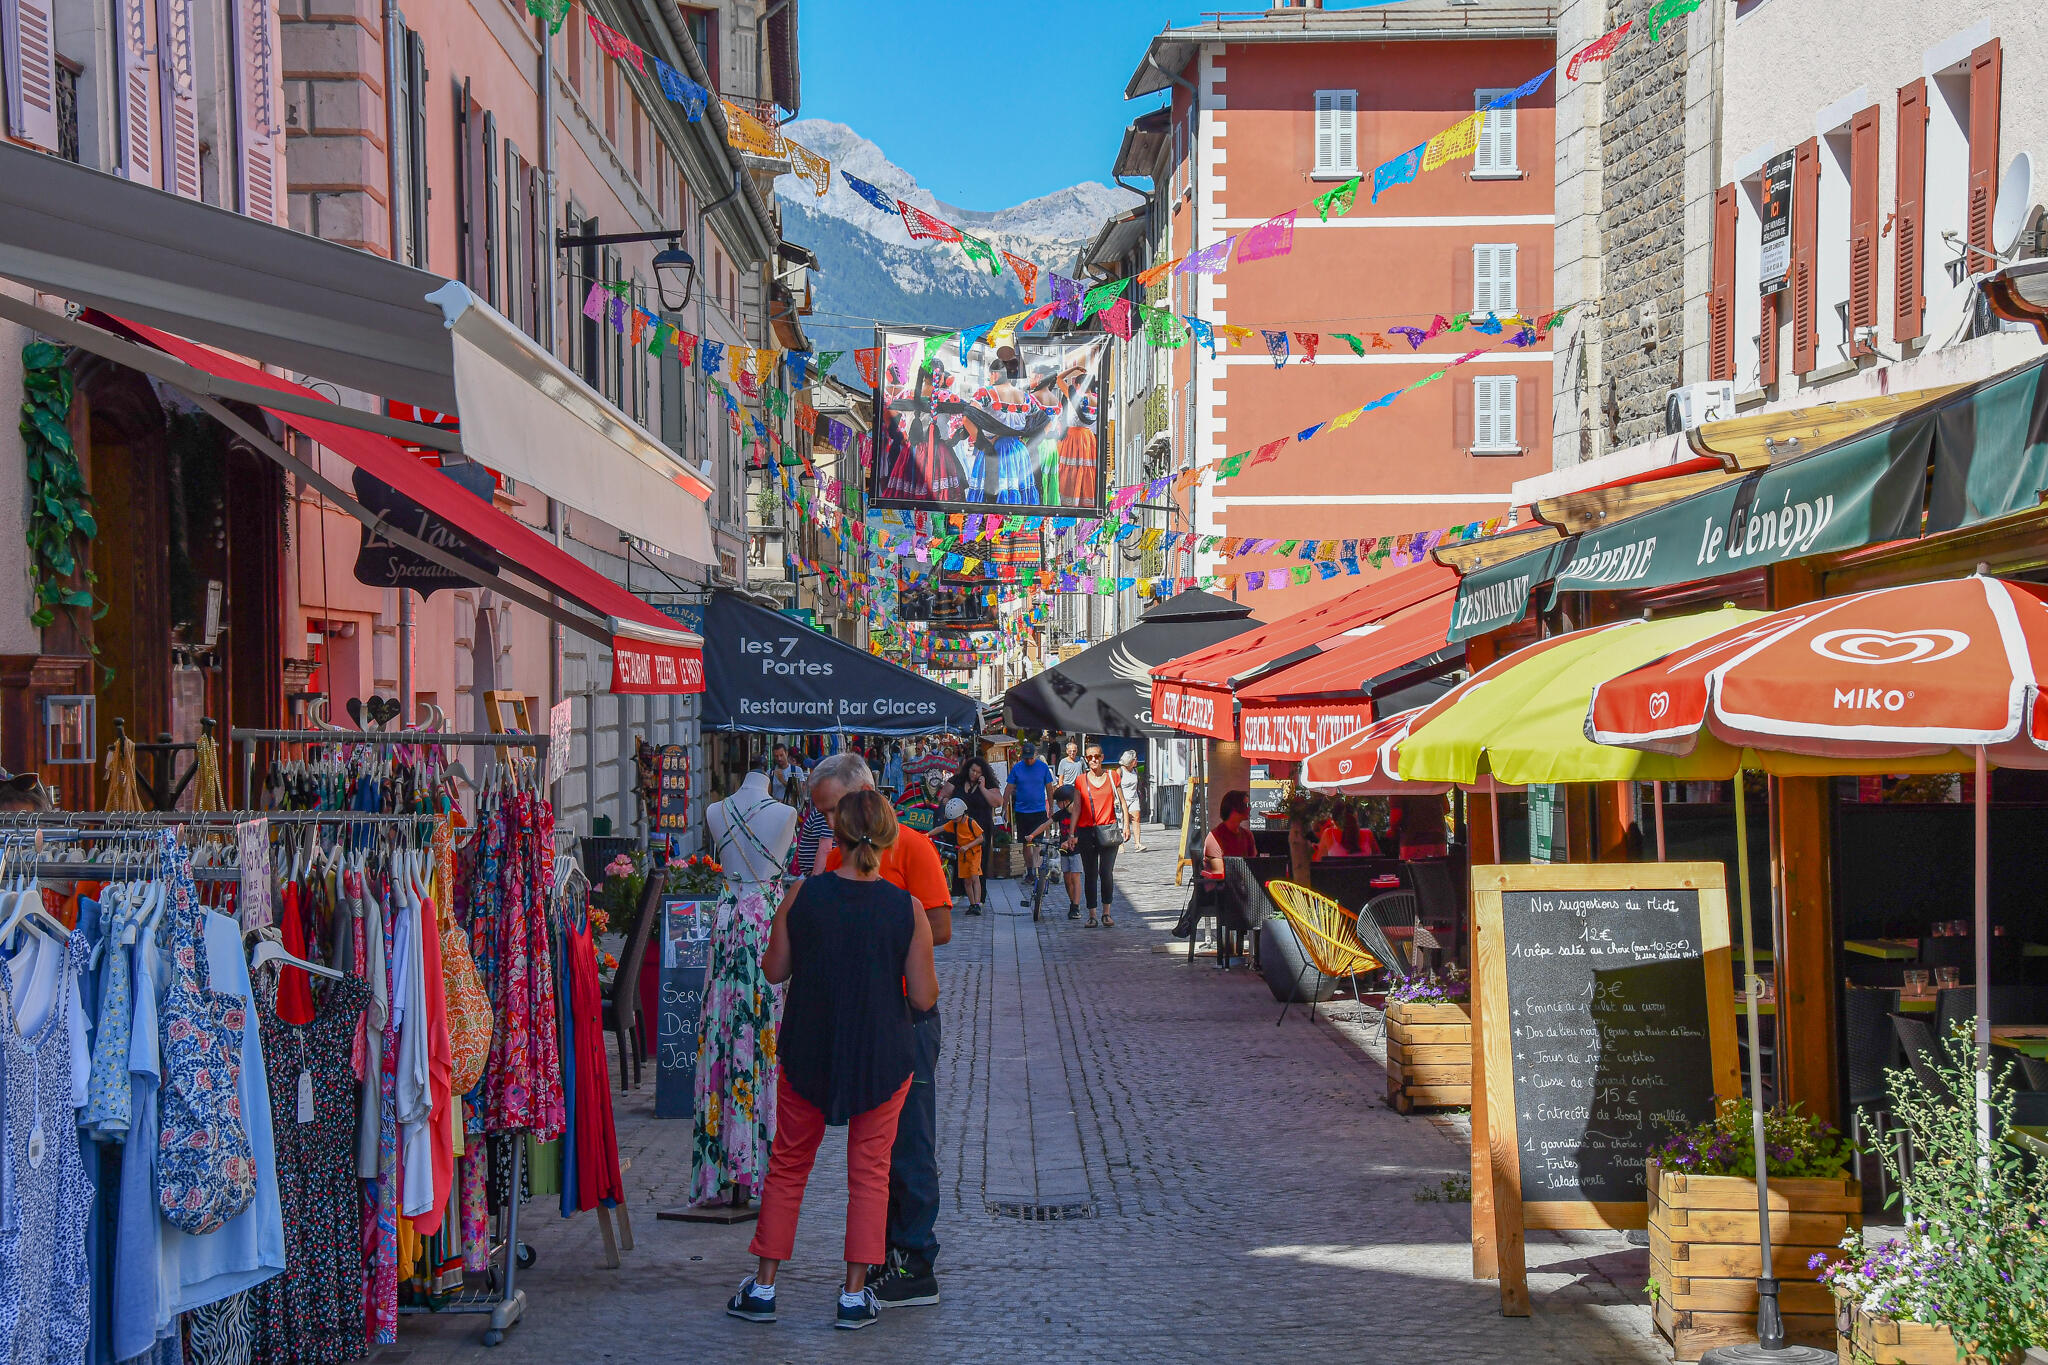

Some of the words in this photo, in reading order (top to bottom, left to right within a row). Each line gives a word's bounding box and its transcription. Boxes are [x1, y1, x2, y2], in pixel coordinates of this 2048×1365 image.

[1697, 516, 1723, 566] le
[1728, 488, 1834, 559] Génépy
[1454, 574, 1529, 630] RESTAURANT
[740, 637, 774, 654] les
[778, 637, 799, 658] 7
[616, 649, 652, 685] RESTAURANT
[762, 659, 833, 676] Portes
[740, 698, 833, 714] Restaurant
[840, 699, 868, 715] Bar
[873, 698, 937, 715] Glaces
[1833, 687, 1905, 711] MIKO
[1531, 898, 1554, 913] Nos
[1558, 898, 1619, 917] suggestions
[1626, 898, 1641, 910] du
[1647, 897, 1679, 912] Midi
[1512, 943, 1521, 958] 1
[1524, 942, 1554, 958] crêpe
[1558, 944, 1586, 956] salée
[1590, 947, 1604, 955] au
[1607, 942, 1631, 954] choix
[1659, 950, 1681, 960] salade
[1623, 1003, 1636, 1012] au
[1641, 1002, 1666, 1018] curry
[1525, 1025, 1544, 1039] Dos
[1546, 1026, 1558, 1037] de
[1559, 1022, 1577, 1037] lieu
[1579, 1027, 1599, 1037] noir
[1567, 1053, 1580, 1063] de
[1594, 1064, 1610, 1072] ou
[1533, 1073, 1566, 1088] Cuisse
[1570, 1076, 1583, 1088] de
[1537, 1103, 1591, 1122] Entrecôte
[1596, 1109, 1609, 1121] de
[1523, 1137, 1536, 1151] 1
[1541, 1138, 1589, 1156] garniture
[1592, 1140, 1606, 1149] au
[1545, 1156, 1580, 1170] Frites
[1613, 1154, 1647, 1168] Ratat
[1548, 1172, 1581, 1189] Salade
[1581, 1174, 1607, 1187] verte
